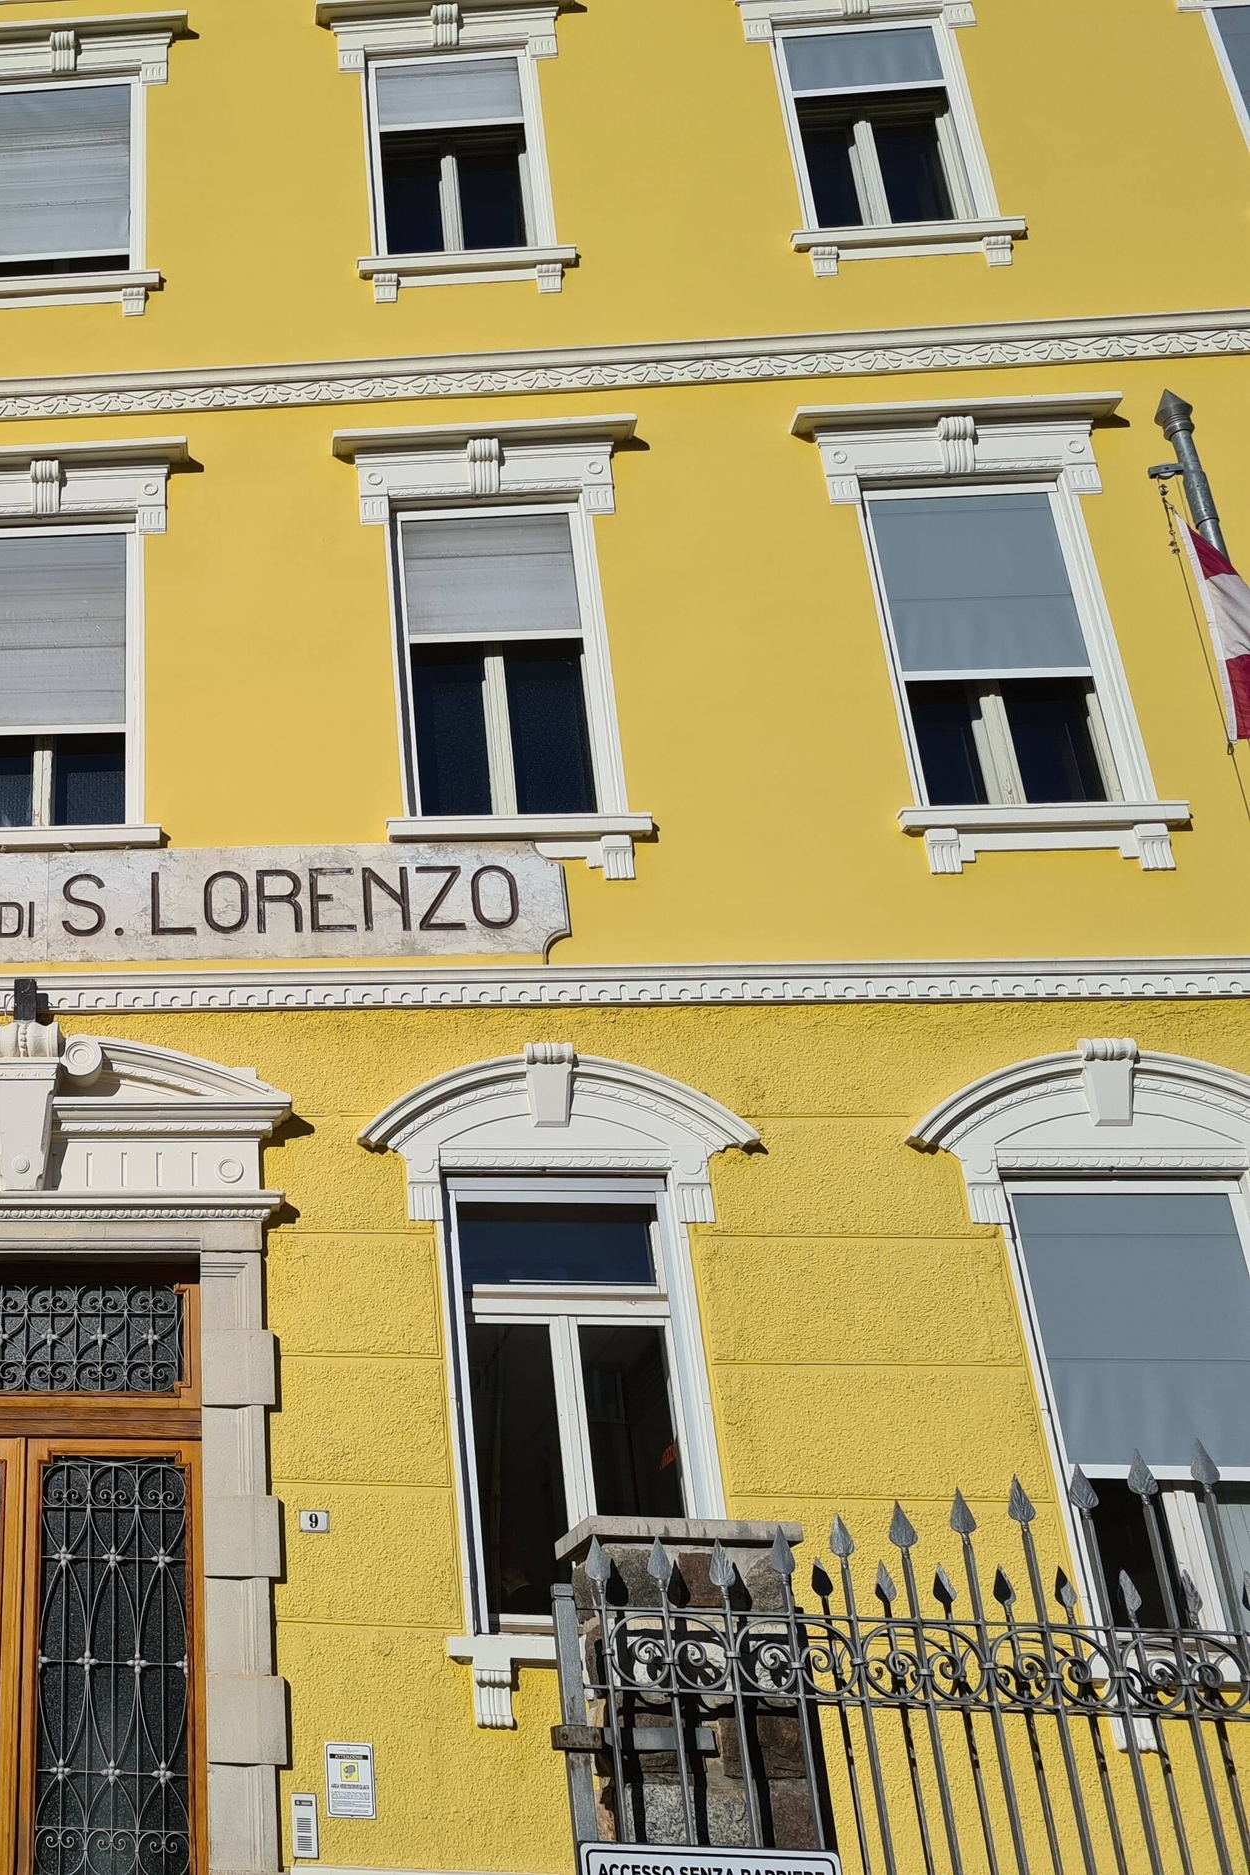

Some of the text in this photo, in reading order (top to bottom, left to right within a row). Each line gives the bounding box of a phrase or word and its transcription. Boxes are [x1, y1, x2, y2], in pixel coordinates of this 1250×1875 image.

[61, 873, 125, 937] S.
[151, 865, 520, 936] LORENZO
[309, 1513, 319, 1529] 9
